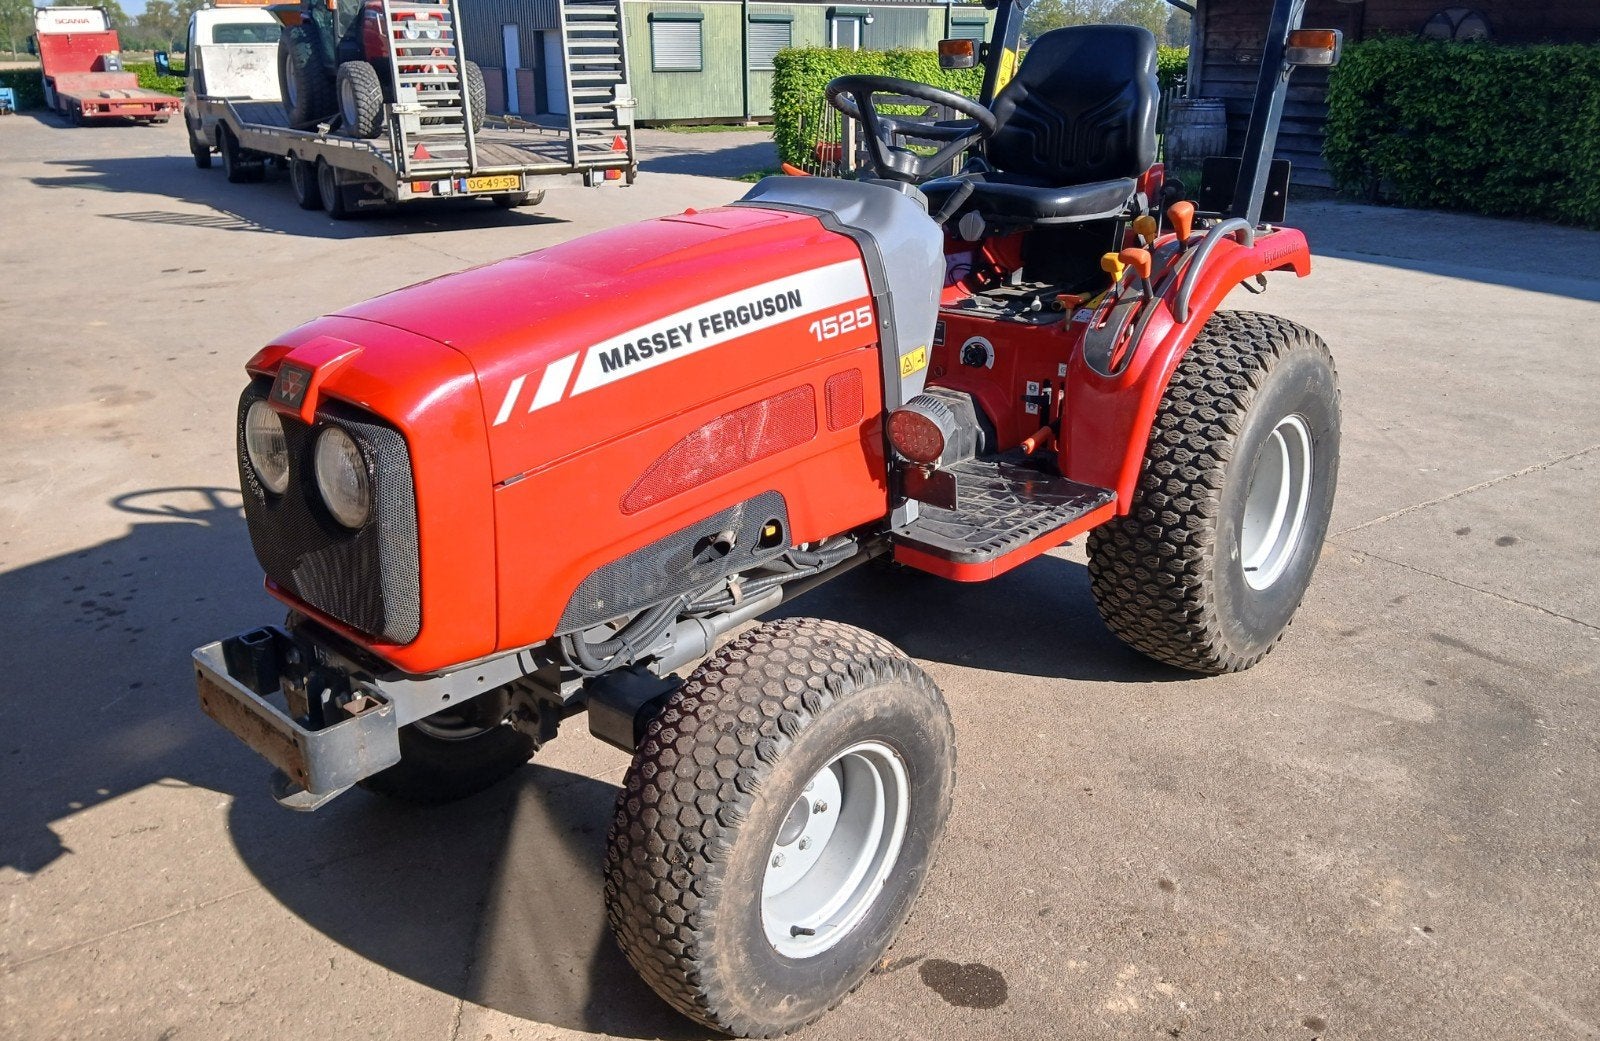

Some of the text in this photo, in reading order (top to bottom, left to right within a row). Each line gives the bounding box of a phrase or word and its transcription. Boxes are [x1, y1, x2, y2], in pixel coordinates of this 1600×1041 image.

[598, 289, 802, 373] MASSEY FERGUSON
[809, 306, 873, 342] 1525
